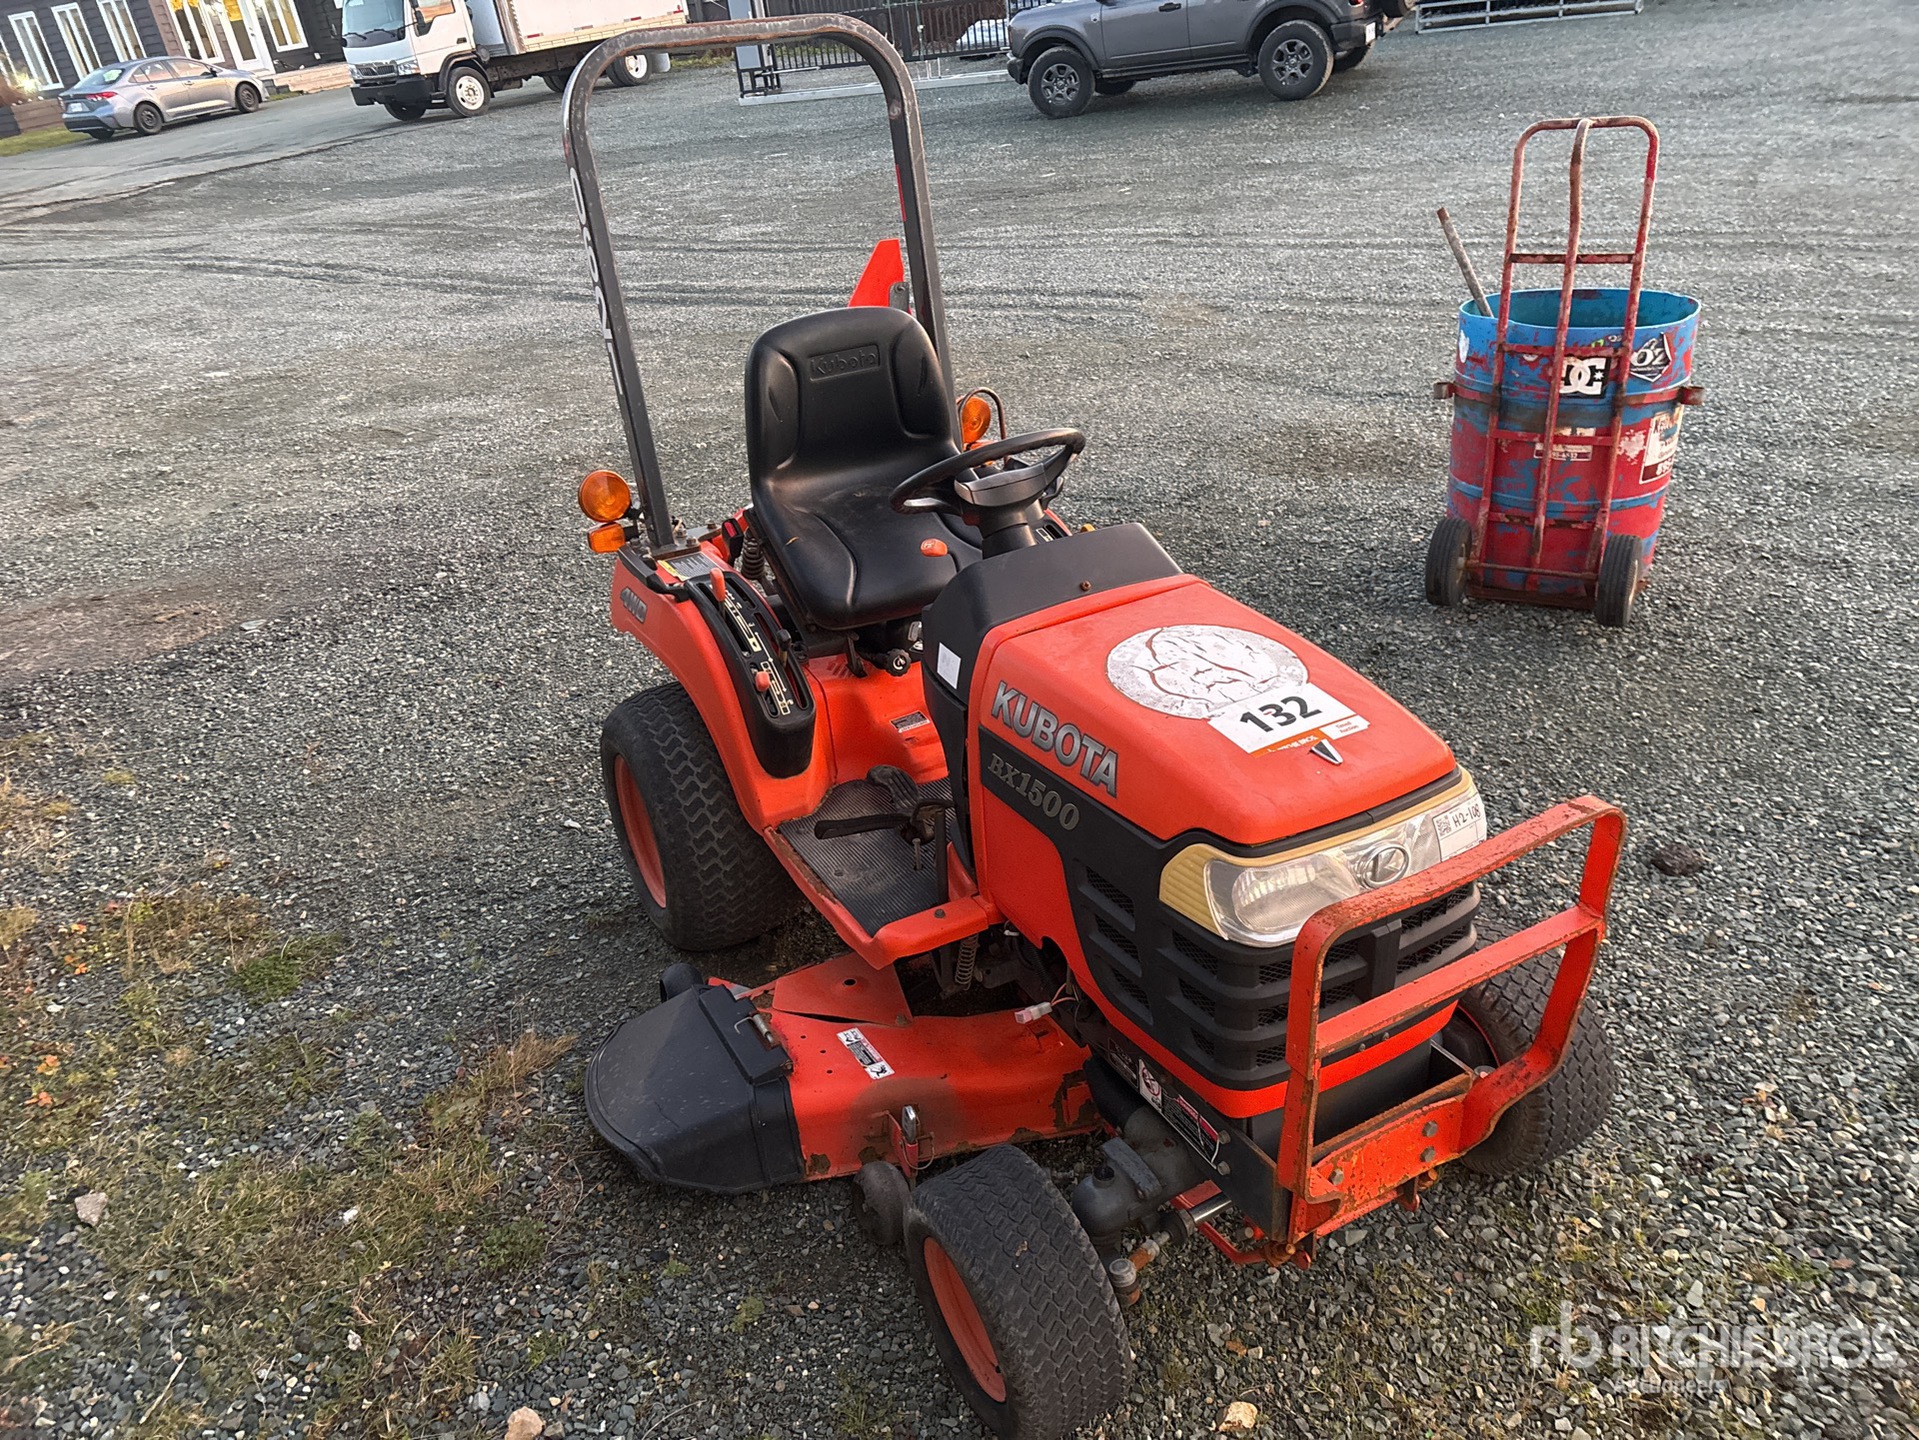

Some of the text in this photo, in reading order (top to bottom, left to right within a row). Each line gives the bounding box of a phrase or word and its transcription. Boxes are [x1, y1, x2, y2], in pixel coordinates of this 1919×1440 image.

[810, 349, 877, 375] Kubota
[991, 680, 1118, 799] KUBOTA
[1240, 696, 1322, 733] 132
[987, 752, 1080, 831] BX1500
